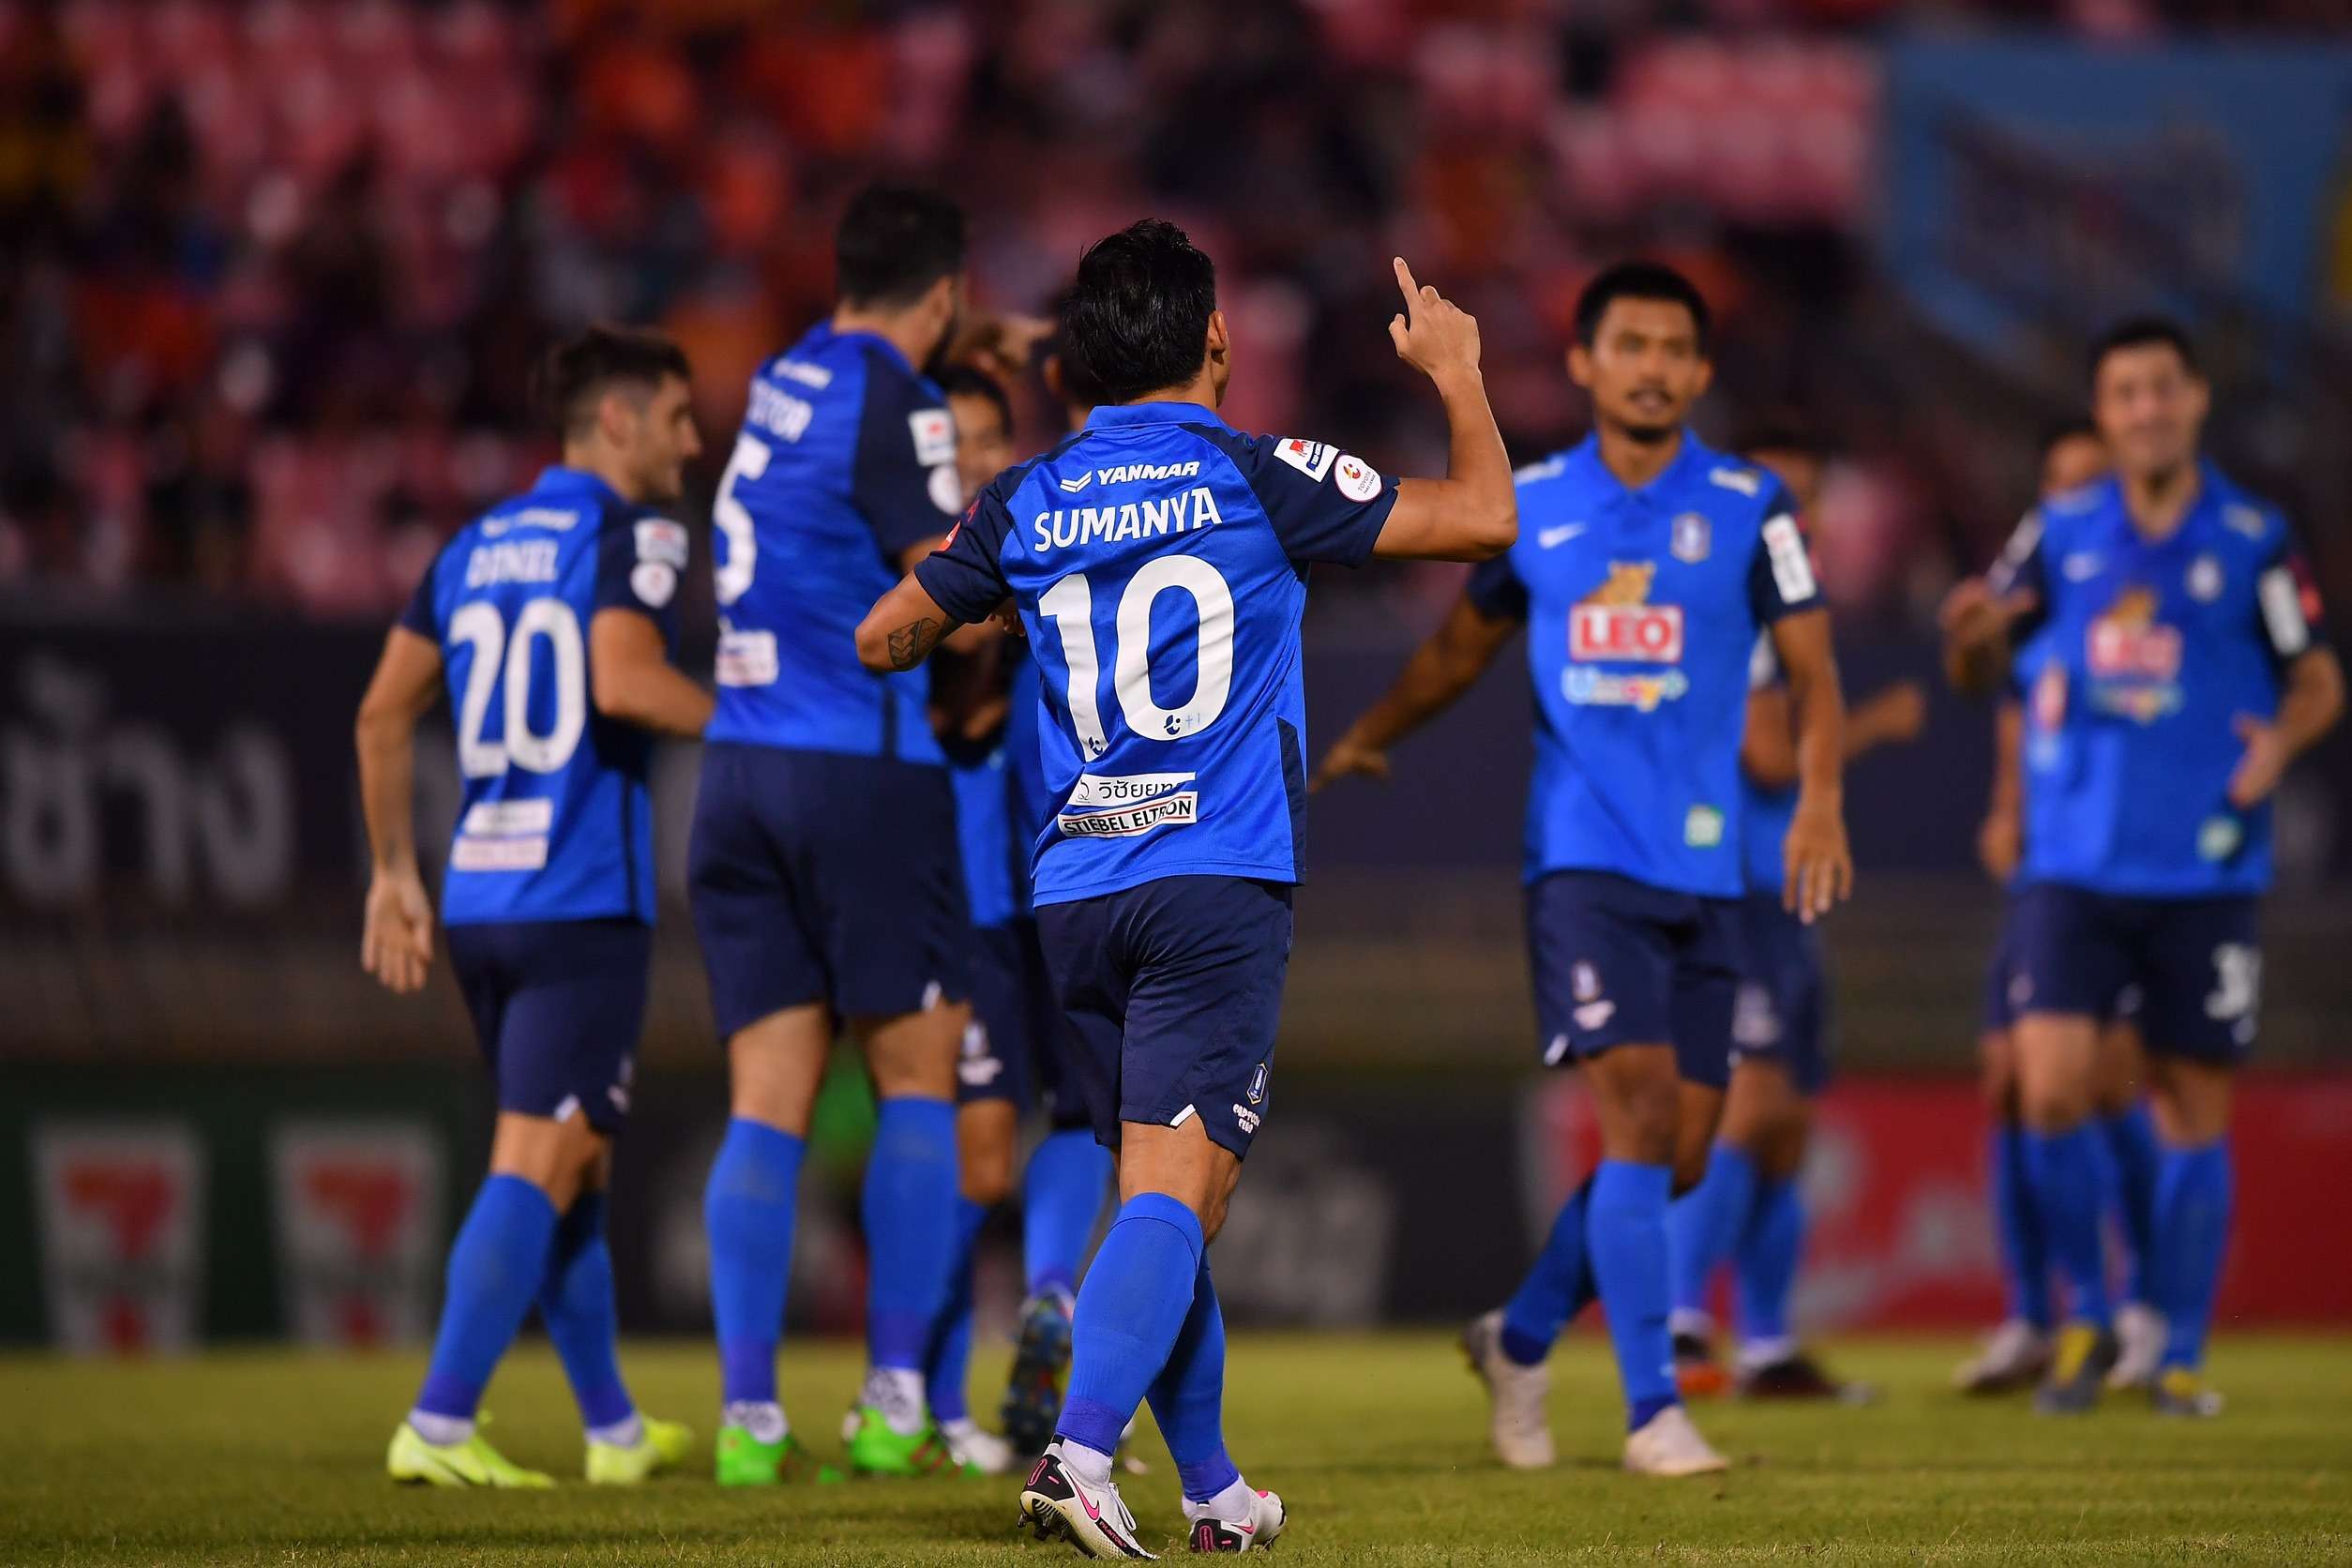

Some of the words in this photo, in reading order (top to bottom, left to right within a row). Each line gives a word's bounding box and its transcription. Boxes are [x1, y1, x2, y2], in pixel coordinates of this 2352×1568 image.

[1097, 460, 1200, 486] YANMAR
[713, 430, 772, 607] 5
[1033, 487, 1223, 552] SUMANYA
[1038, 554, 1235, 762] 10
[1580, 613, 1672, 656] LEO
[448, 597, 587, 778] 20
[1063, 814, 1130, 834] STIEBEL
[1132, 800, 1192, 827] ELTRON
